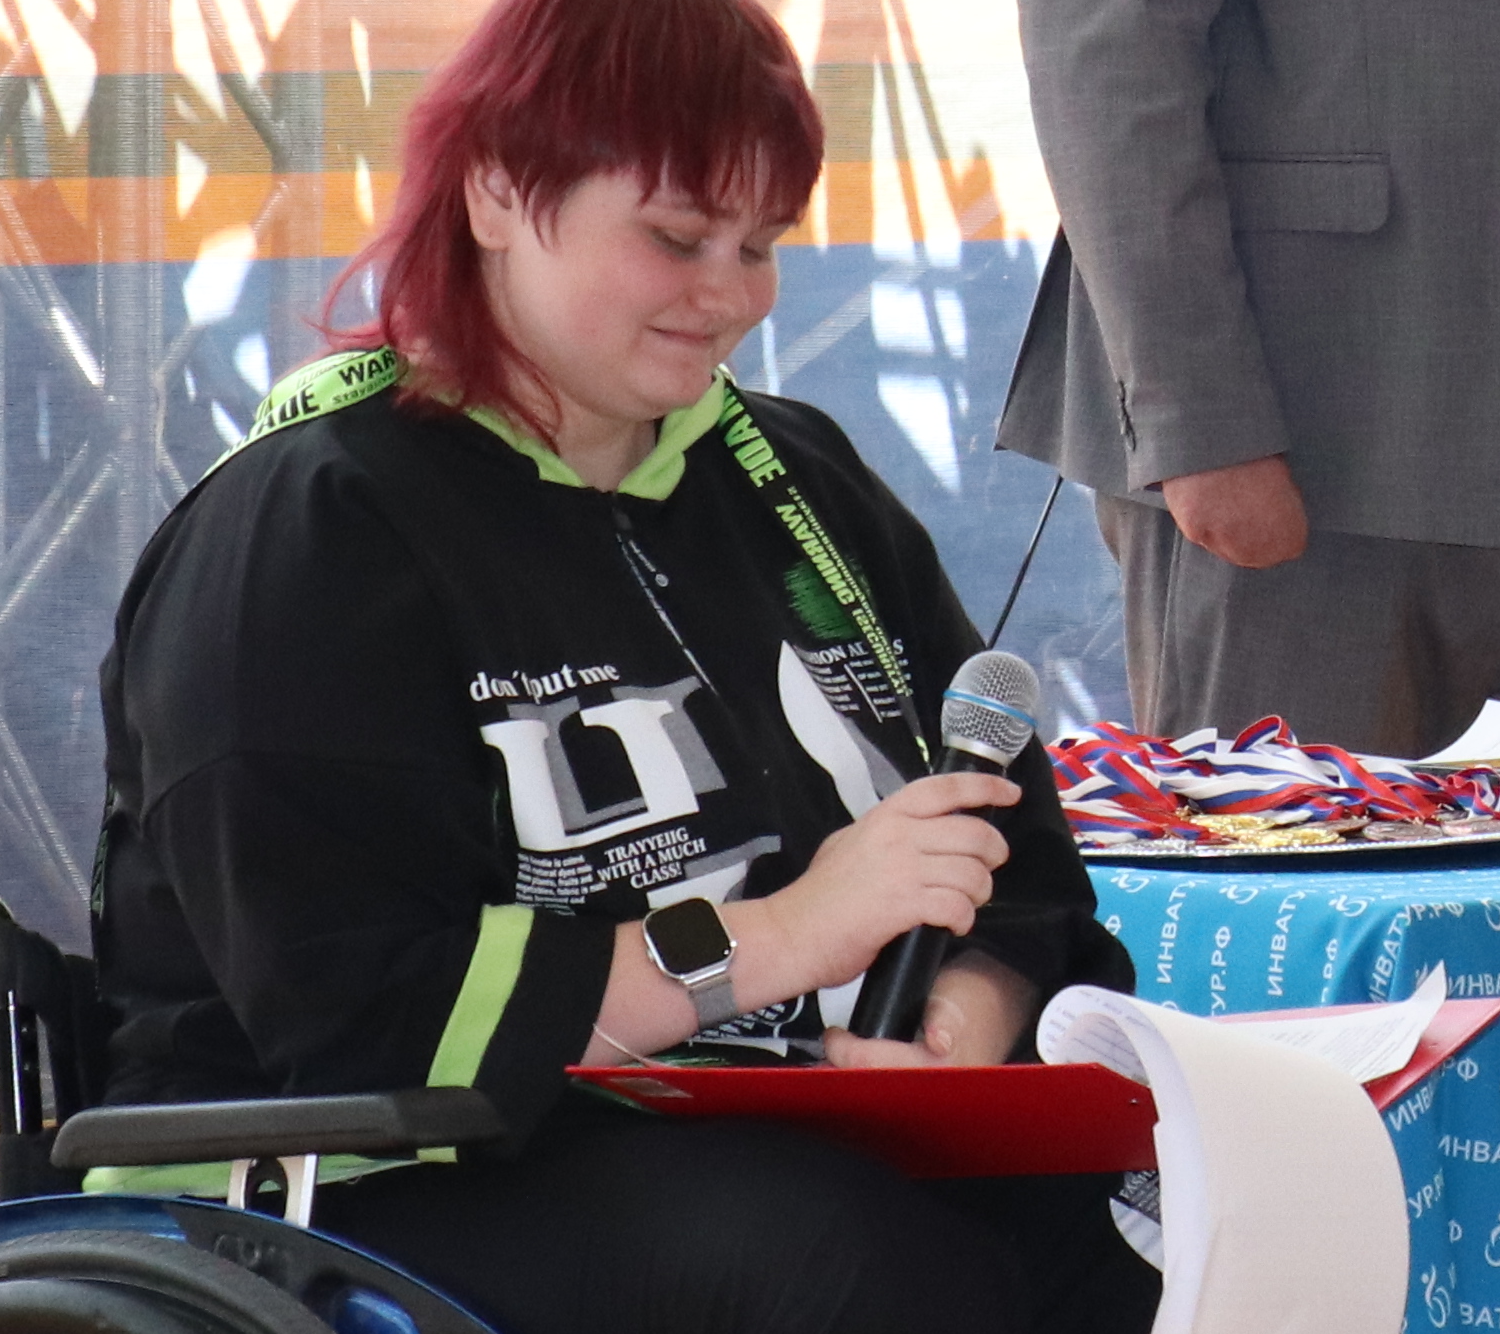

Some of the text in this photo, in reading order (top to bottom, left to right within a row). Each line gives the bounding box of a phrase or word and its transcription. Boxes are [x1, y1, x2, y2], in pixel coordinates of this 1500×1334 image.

[578, 663, 621, 685] me
[597, 856, 642, 883] WITH
[644, 853, 658, 870] A
[658, 837, 708, 864] MUCH
[630, 861, 683, 890] CLASS!
